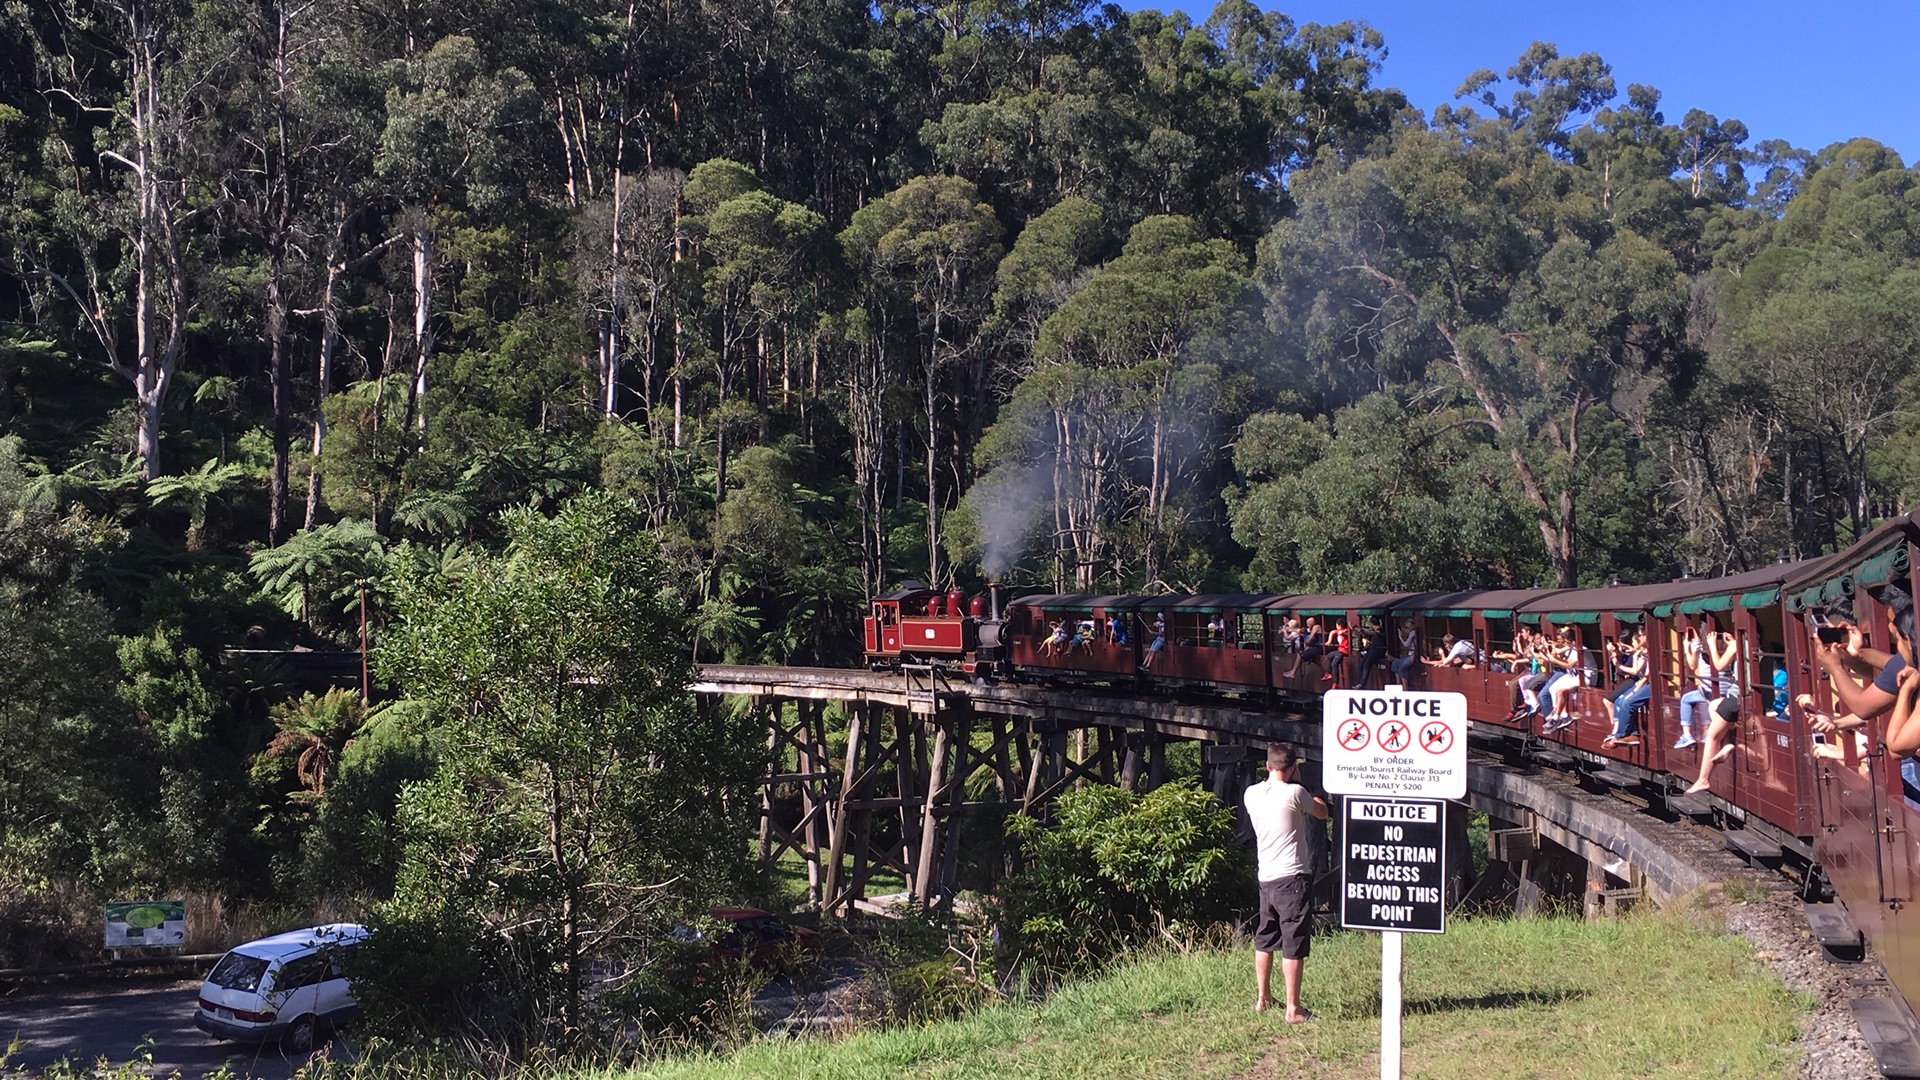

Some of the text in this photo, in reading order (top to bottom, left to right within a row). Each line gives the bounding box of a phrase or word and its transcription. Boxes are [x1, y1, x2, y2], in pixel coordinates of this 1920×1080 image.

[1349, 698, 1441, 717] NOTICE
[1397, 767, 1426, 775] Railway
[1363, 804, 1427, 819] NOTICE
[1384, 826, 1403, 841] NO
[1352, 844, 1436, 863] PEDESTRIAN
[1367, 864, 1420, 882] ACCESS
[1348, 883, 1439, 903] BEYOND THIS
[1372, 904, 1414, 921] POINT
